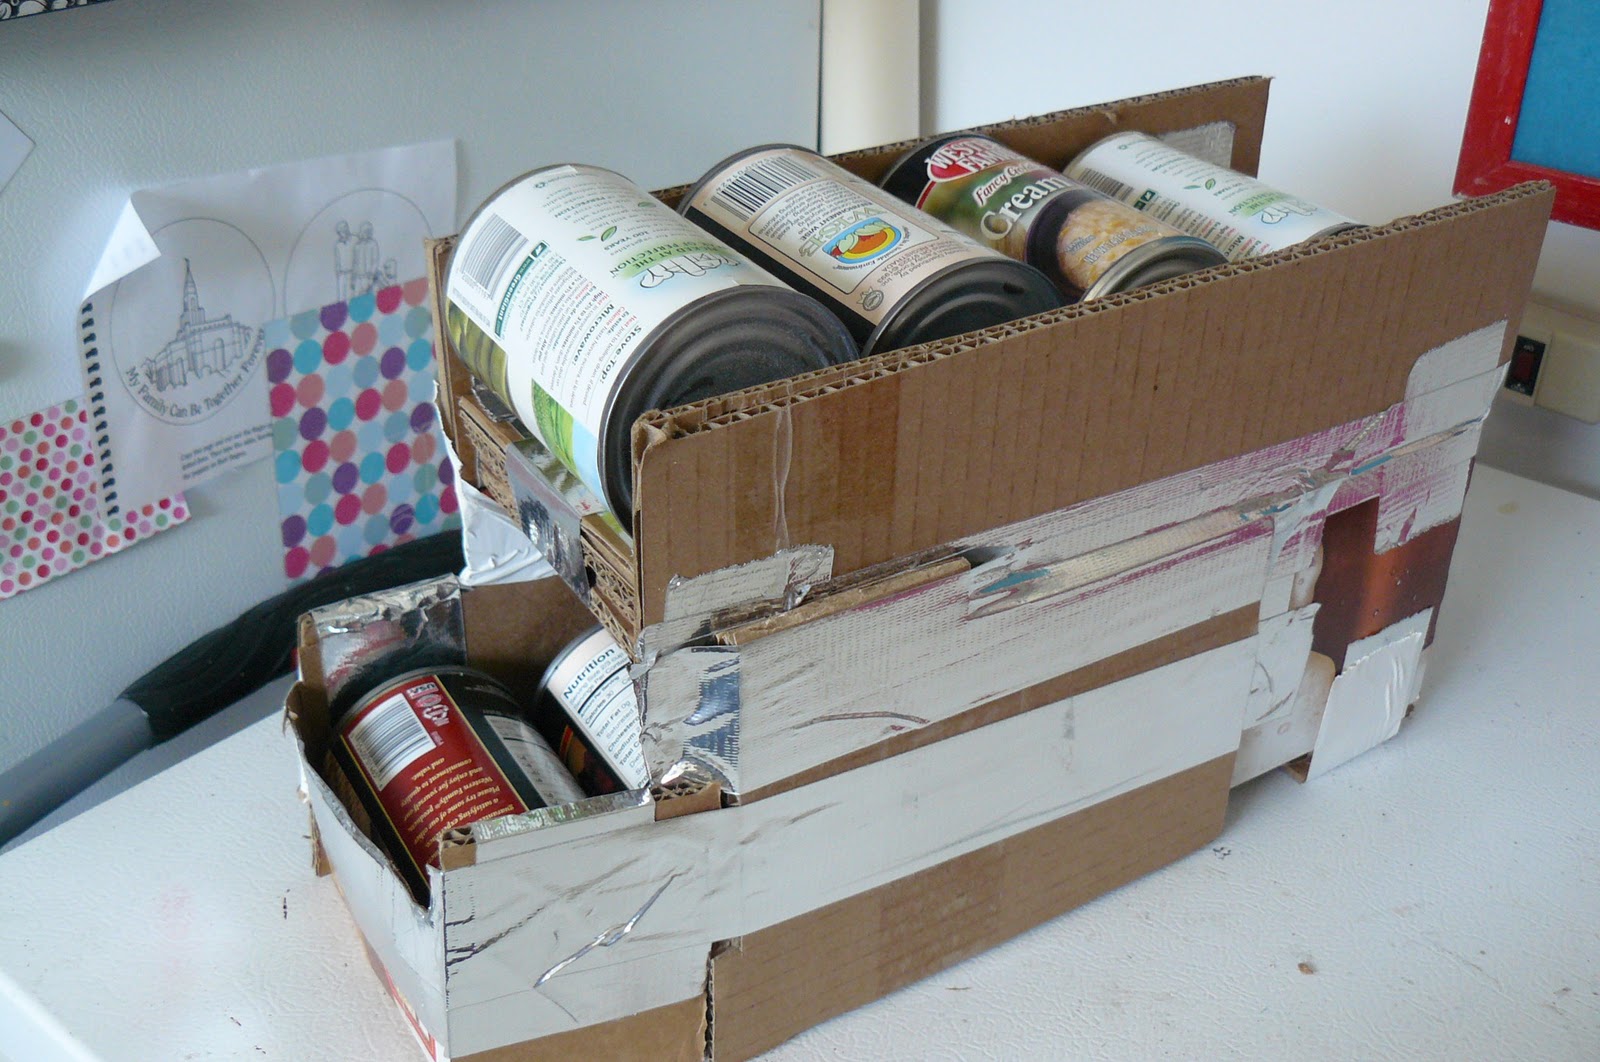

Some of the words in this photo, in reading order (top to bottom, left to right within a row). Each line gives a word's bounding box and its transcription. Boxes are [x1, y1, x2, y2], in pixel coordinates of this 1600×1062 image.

[974, 173, 1008, 204] Fancy
[976, 179, 1073, 238] Cream
[798, 224, 818, 241] WISE
[1223, 234, 1244, 258] Micro
[608, 242, 679, 275] PERFECTION
[632, 256, 655, 268] THE
[908, 253, 944, 272] Distributed
[899, 270, 908, 278] by
[574, 280, 592, 300] Caliente
[588, 285, 596, 293] En
[590, 289, 604, 302] High
[574, 291, 590, 308] horno
[596, 293, 609, 305] Heat
[569, 307, 576, 316] de
[605, 305, 625, 326] Caliente
[621, 310, 629, 318] En
[623, 314, 637, 327] Heat
[571, 303, 614, 365] Microwave:
[605, 317, 623, 336] estufa:
[597, 324, 642, 384] Stove-Top:
[125, 365, 140, 387] My
[137, 384, 168, 416] Family
[170, 404, 187, 417] Can
[190, 404, 202, 415] Be
[204, 373, 243, 410] Together
[241, 327, 265, 374] Forever
[563, 647, 614, 698] Nutrition
[569, 681, 588, 703] Serving
[586, 668, 600, 682] Size
[610, 651, 623, 662] cup
[593, 673, 605, 684] Per
[604, 654, 629, 674] Contain
[594, 690, 602, 699] Per
[601, 675, 619, 691] Serving
[584, 698, 606, 724] Calories
[604, 689, 614, 698] 30
[595, 719, 611, 738] Total
[609, 707, 621, 720] Fat
[620, 699, 631, 709] 0g
[604, 707, 635, 739] Saturated
[606, 713, 640, 752] Cholester
[611, 731, 637, 759] Sodium
[430, 756, 445, 769] and
[618, 746, 635, 766] Total
[627, 750, 643, 768] Diet
[411, 765, 431, 780] value.
[428, 758, 472, 783] commitment
[449, 771, 468, 784] enjoy
[468, 765, 483, 776] and
[420, 781, 429, 789] to
[437, 779, 449, 792] for
[462, 775, 493, 790] Western
[477, 785, 500, 795] Please
[399, 785, 421, 807] quality
[412, 787, 438, 812] yourself
[465, 793, 477, 802] try
[402, 809, 414, 821] our
[446, 799, 465, 813] some
[456, 799, 493, 820] satisfying
[427, 816, 439, 829] our
[438, 810, 448, 822] of
[412, 827, 428, 844] other
